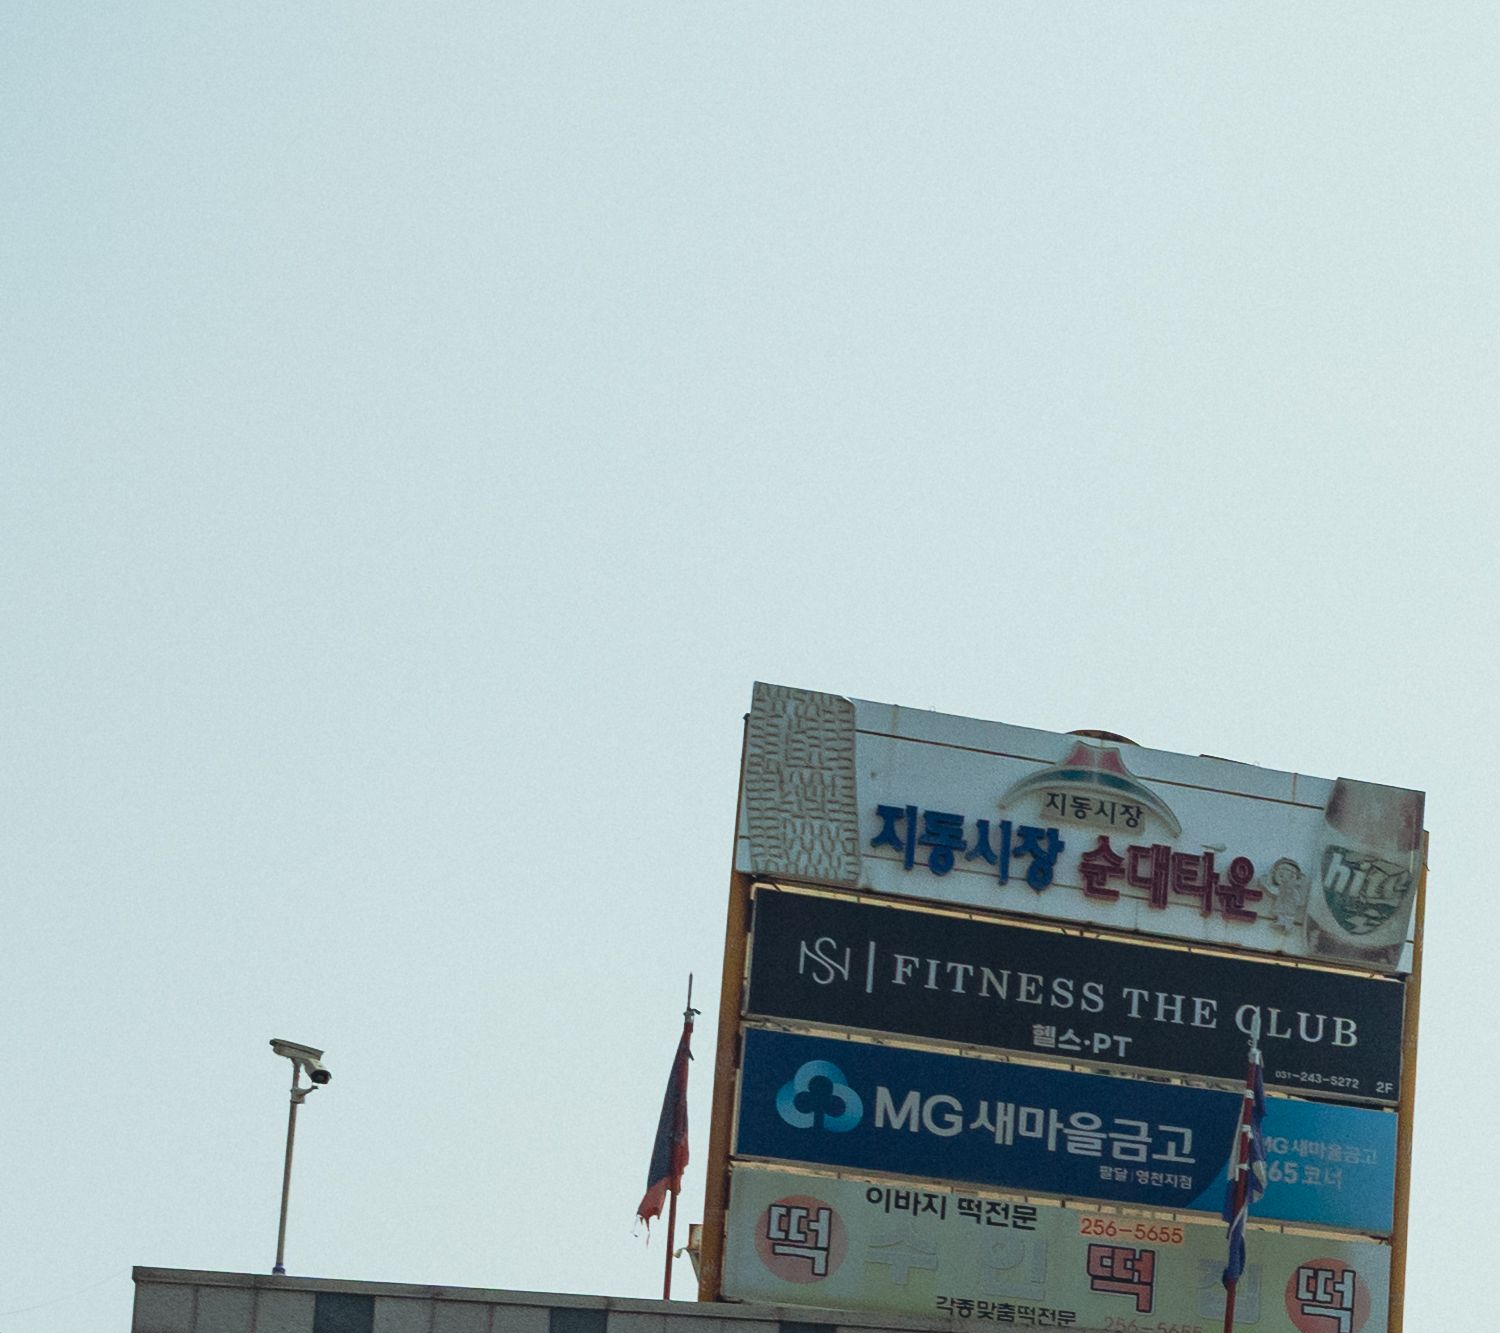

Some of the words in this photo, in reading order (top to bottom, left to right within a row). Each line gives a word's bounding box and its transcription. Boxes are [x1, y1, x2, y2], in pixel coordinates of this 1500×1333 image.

[1044, 791, 1145, 828] 지동시장
[870, 803, 1066, 894] 지동시장
[1078, 834, 1264, 923] 순대타운
[892, 953, 1106, 1014] FITNESS
[1121, 987, 1219, 1030] THE
[1234, 1003, 1361, 1048] CLUB
[1031, 1022, 1134, 1059] 헬스·PT
[872, 1085, 964, 1138] MG
[969, 1096, 1197, 1166] 새마을금고
[1291, 1140, 1379, 1167] 새마을금고
[1301, 1165, 1344, 1191] 코너
[865, 1186, 947, 1221] 이바지
[956, 1196, 1038, 1232] 떡전문
[766, 1203, 833, 1277] 떡
[1080, 1216, 1185, 1245] 256-5655
